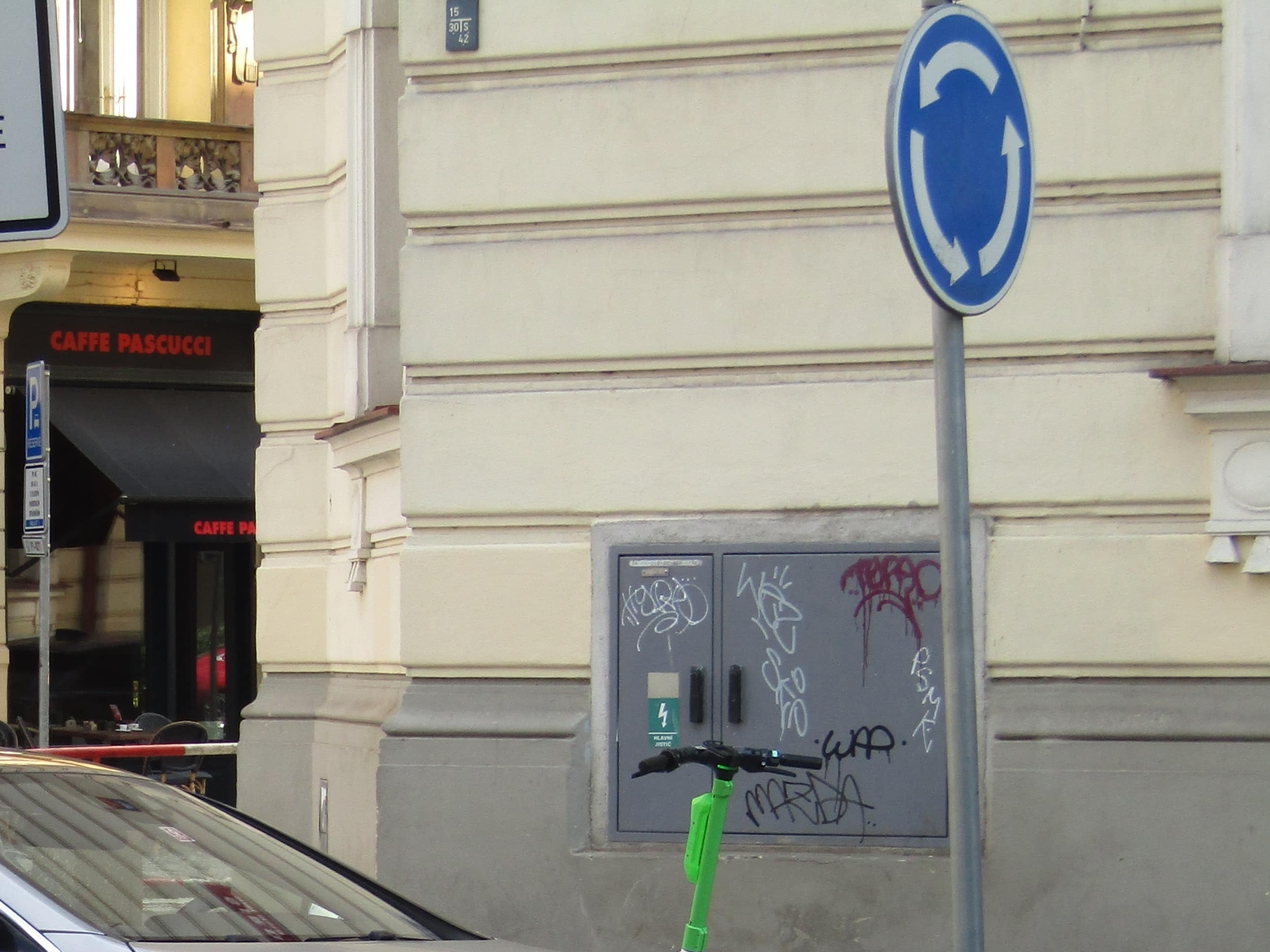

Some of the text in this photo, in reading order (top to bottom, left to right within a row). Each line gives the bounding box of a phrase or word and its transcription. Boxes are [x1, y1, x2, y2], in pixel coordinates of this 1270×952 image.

[450, 7, 459, 17] 15
[449, 22, 459, 32] 30
[458, 34, 469, 44] 42
[50, 331, 212, 356] CAFFE PASCUCCI
[194, 521, 234, 535] CAFFE
